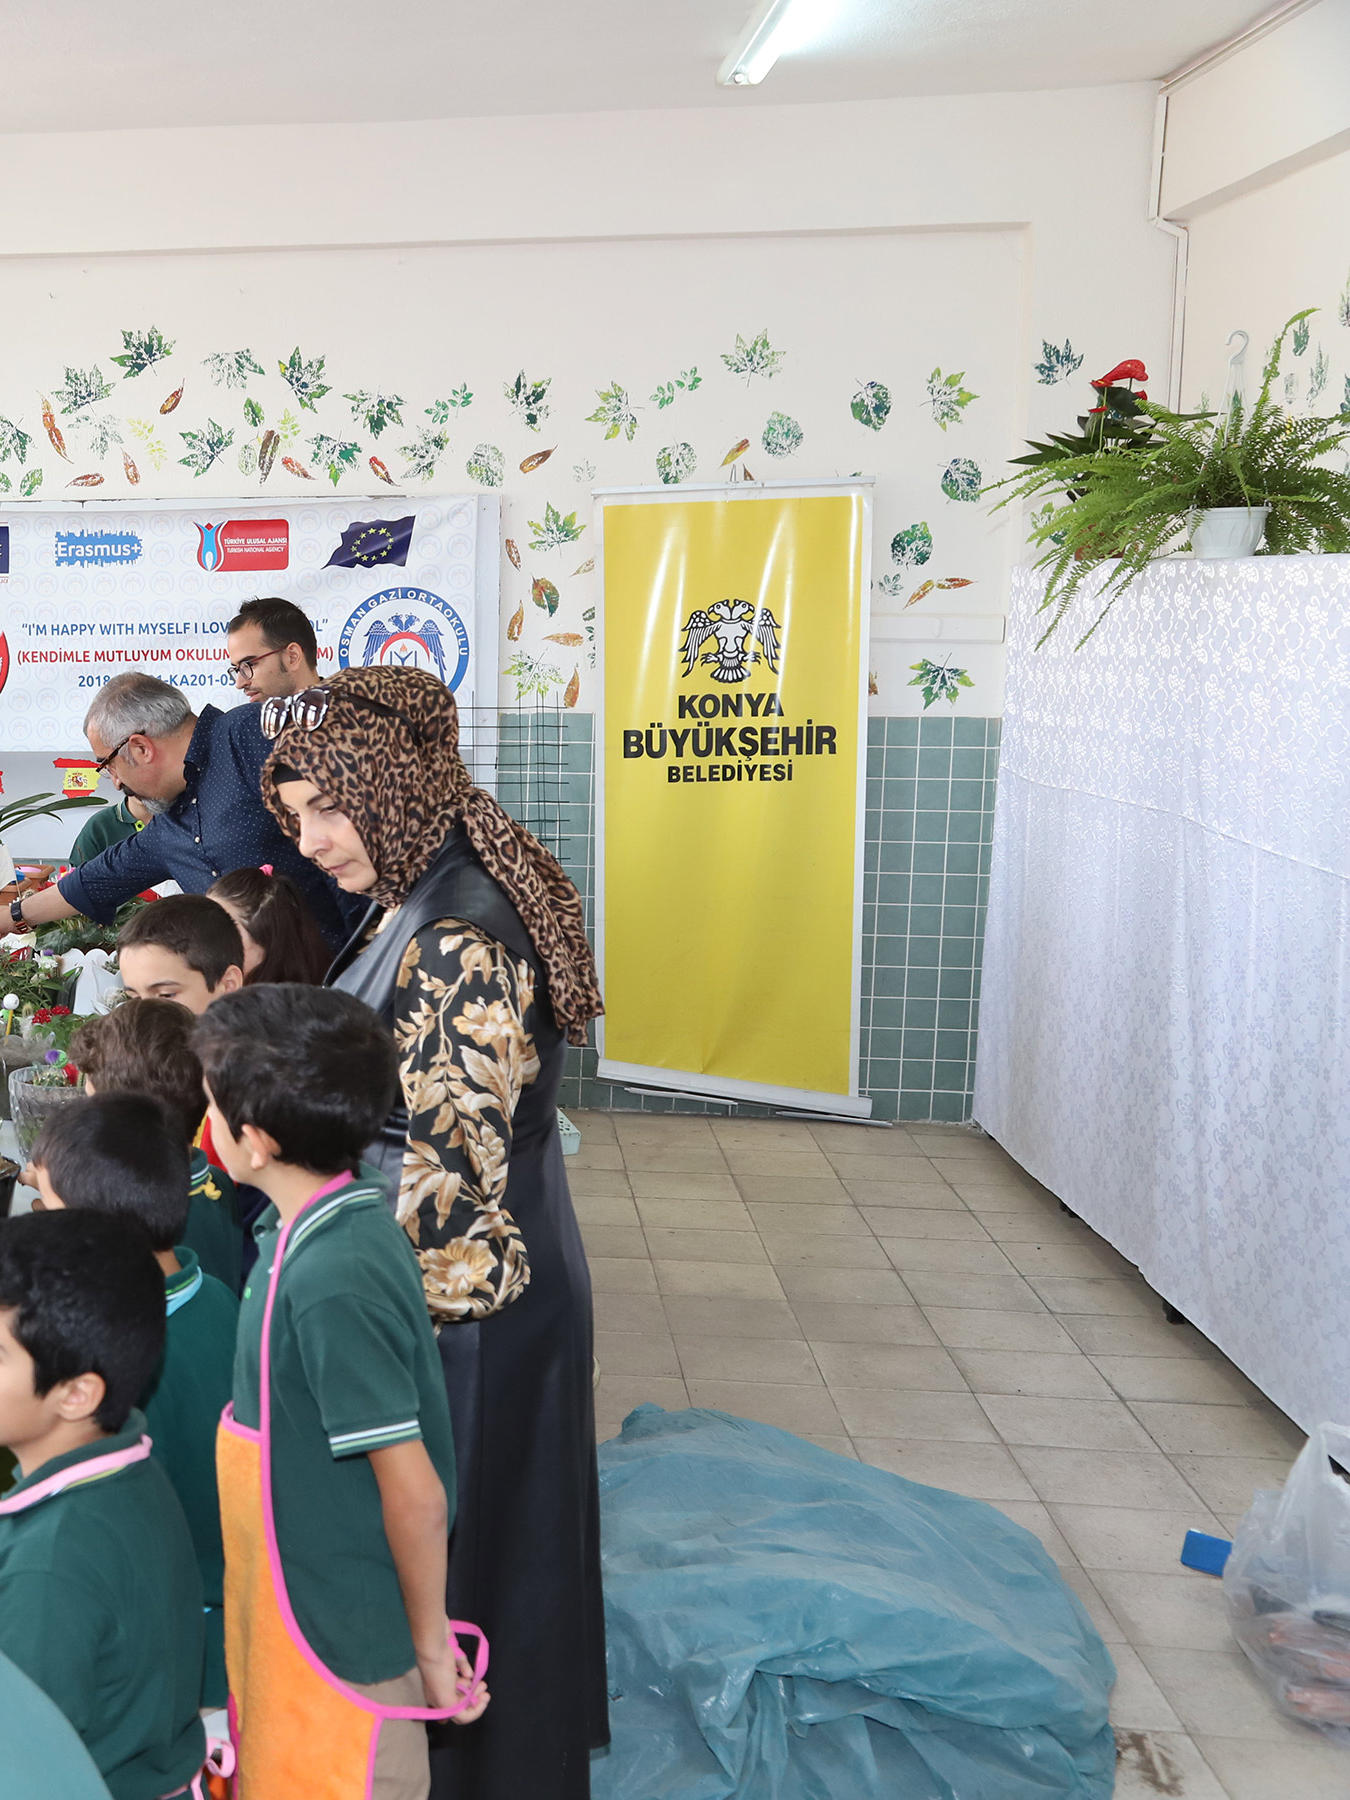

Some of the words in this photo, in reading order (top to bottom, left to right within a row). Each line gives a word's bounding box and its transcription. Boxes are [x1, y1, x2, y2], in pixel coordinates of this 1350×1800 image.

[57, 542, 141, 557] Erasmus+
[51, 624, 96, 636] HAPPY
[99, 623, 134, 635] WITH
[138, 622, 191, 635] MYSELF
[194, 622, 198, 634] I
[202, 621, 230, 634] LOV
[340, 607, 367, 658] OSMAN
[368, 588, 402, 608] GAZİ
[407, 590, 468, 656] ORTAOKULU
[17, 647, 90, 665] (KENDİMLE
[94, 649, 171, 662] MUTLUYUM
[678, 692, 785, 719] KONYA
[622, 718, 838, 762] BÜYÜKŞEHİR
[667, 759, 794, 783] BELEDİYESİ
